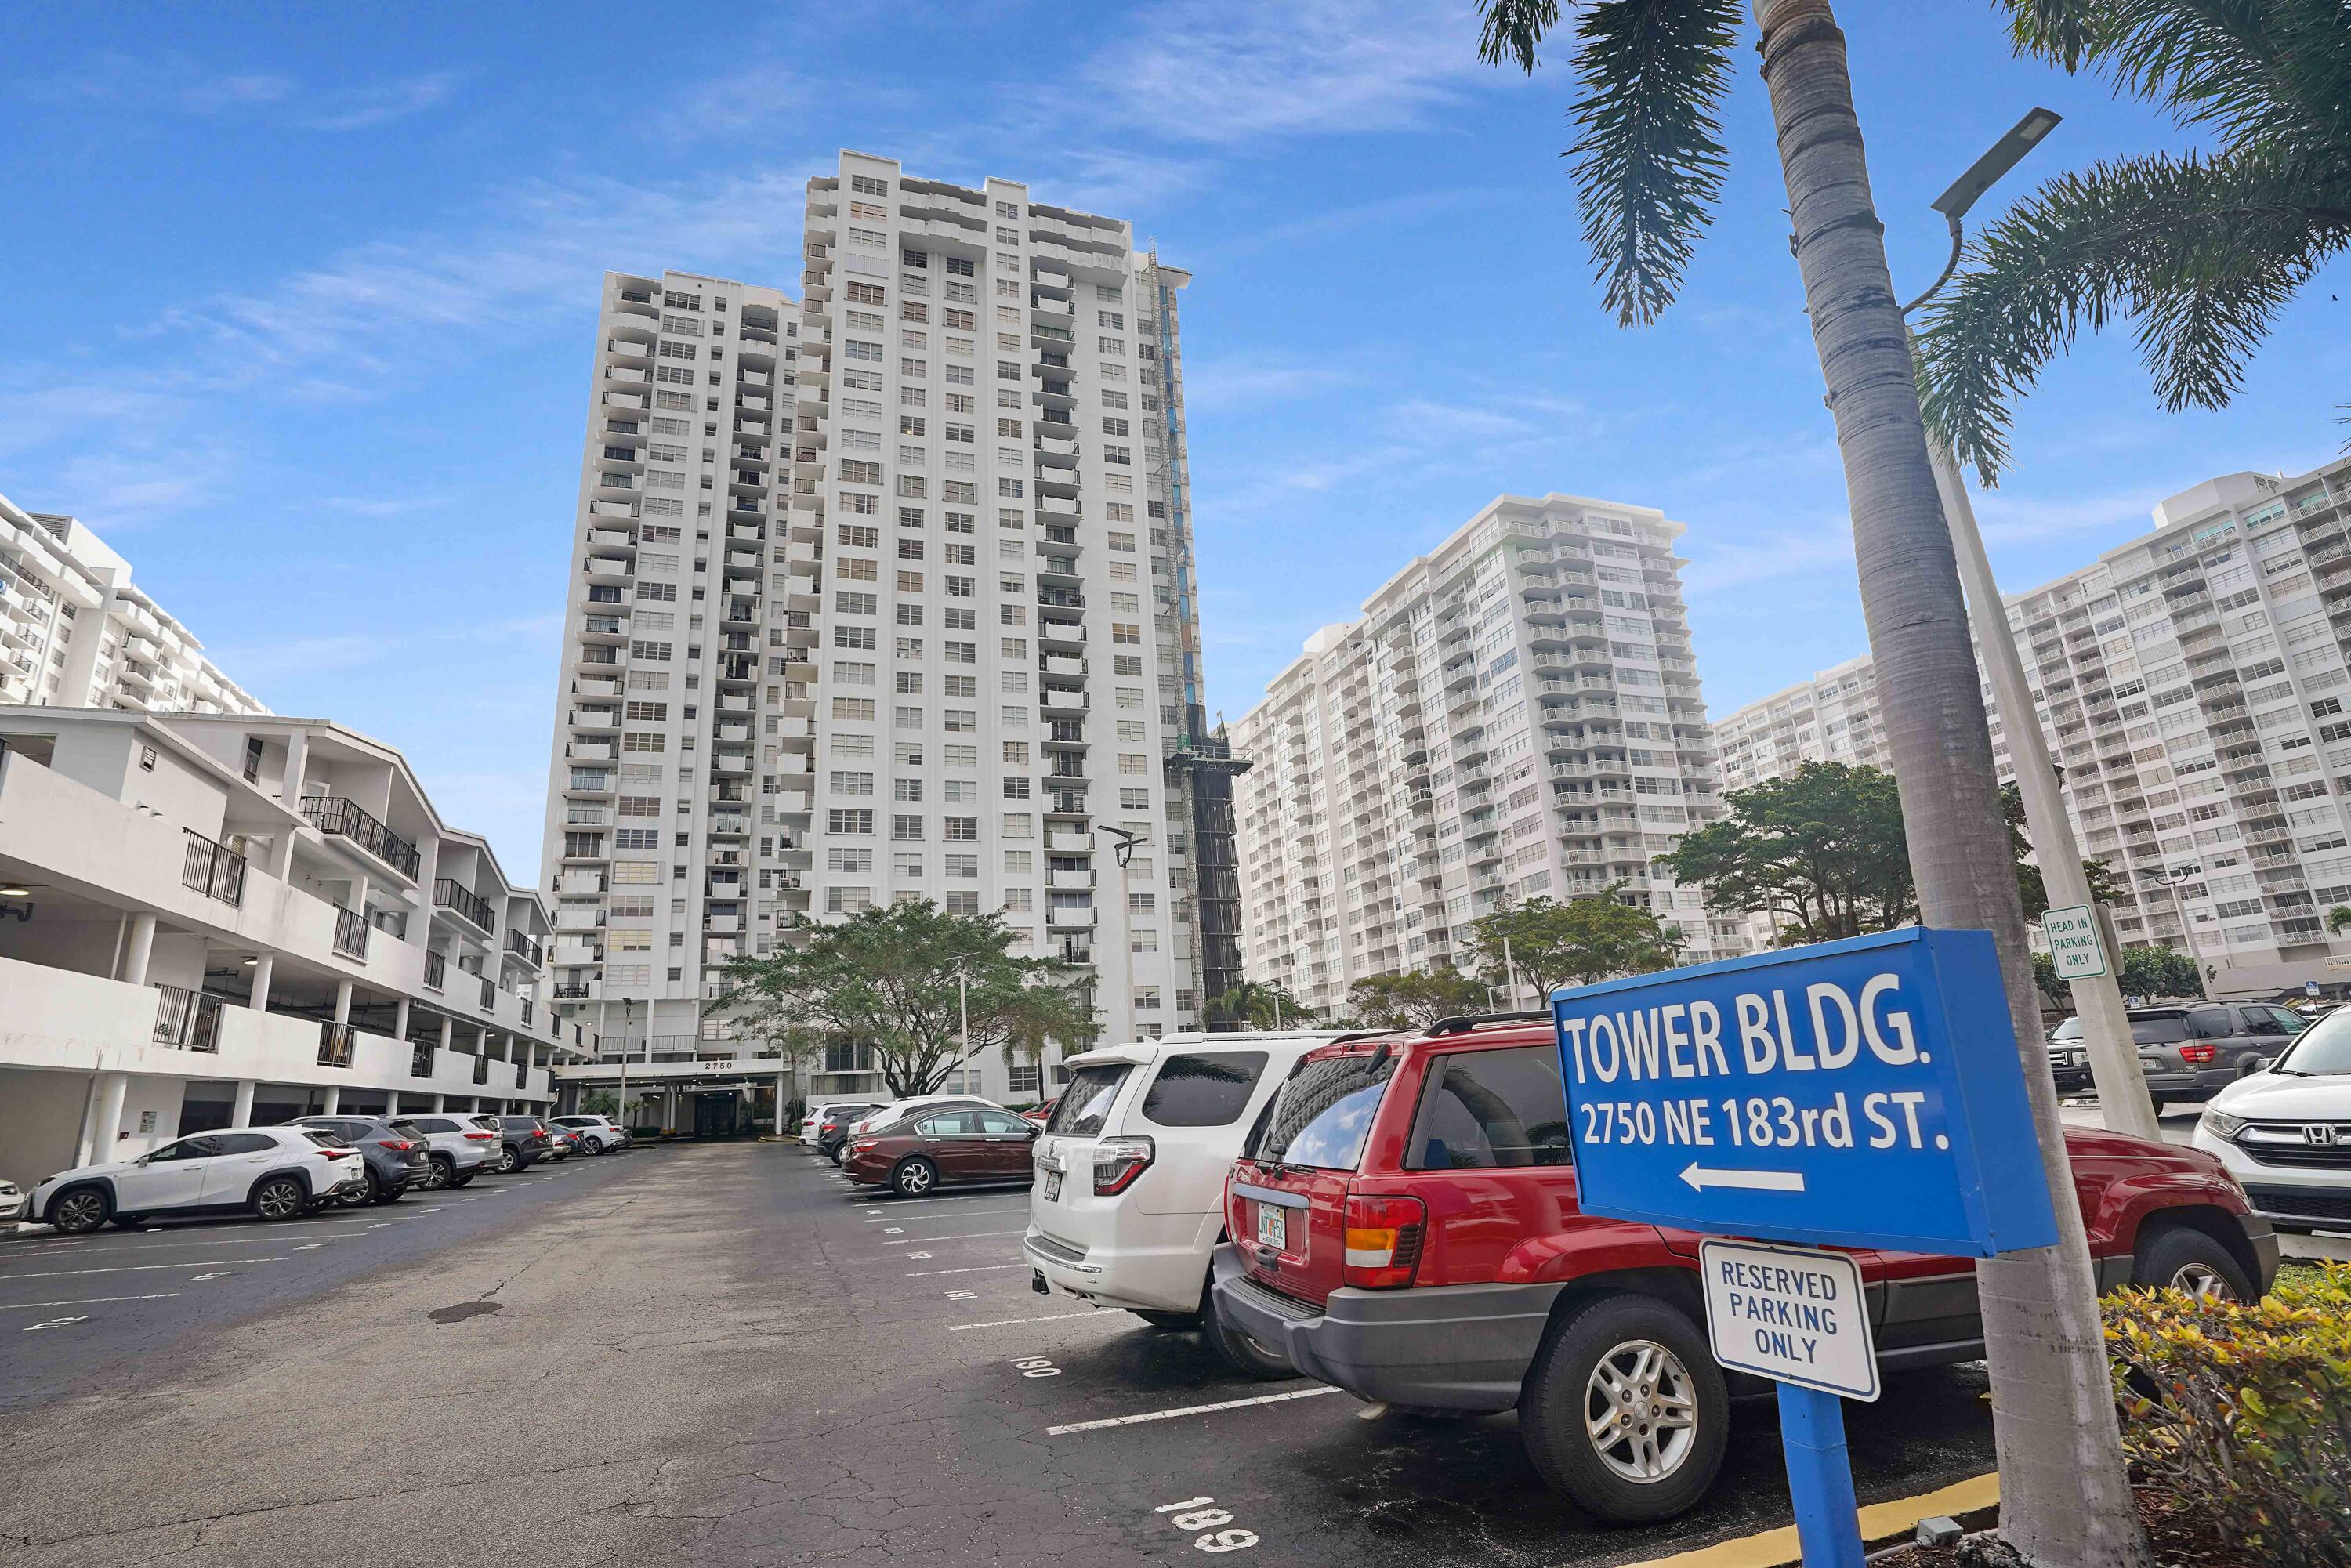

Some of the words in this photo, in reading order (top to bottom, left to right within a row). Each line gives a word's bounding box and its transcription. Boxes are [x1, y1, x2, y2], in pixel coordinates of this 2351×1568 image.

[2050, 920, 2074, 933] HEAD
[2077, 918, 2088, 929] IN
[2054, 934, 2093, 951] PARKING
[2066, 953, 2089, 966] ONLY
[1563, 1000, 1730, 1084] TOWER
[1735, 973, 1930, 1074] BLDG.
[1581, 1101, 1656, 1145] 2750
[1663, 1099, 1714, 1146] NE
[1722, 1092, 1853, 1148] 183rd
[1864, 1092, 1949, 1150] ST.
[944, 1290, 978, 1301] 191
[1721, 1260, 1836, 1301] RESERVED
[1730, 1292, 1837, 1334] PARKING
[1755, 1328, 1817, 1364] ONLY
[1010, 1355, 1062, 1378] 190
[1154, 1497, 1259, 1552] 189
